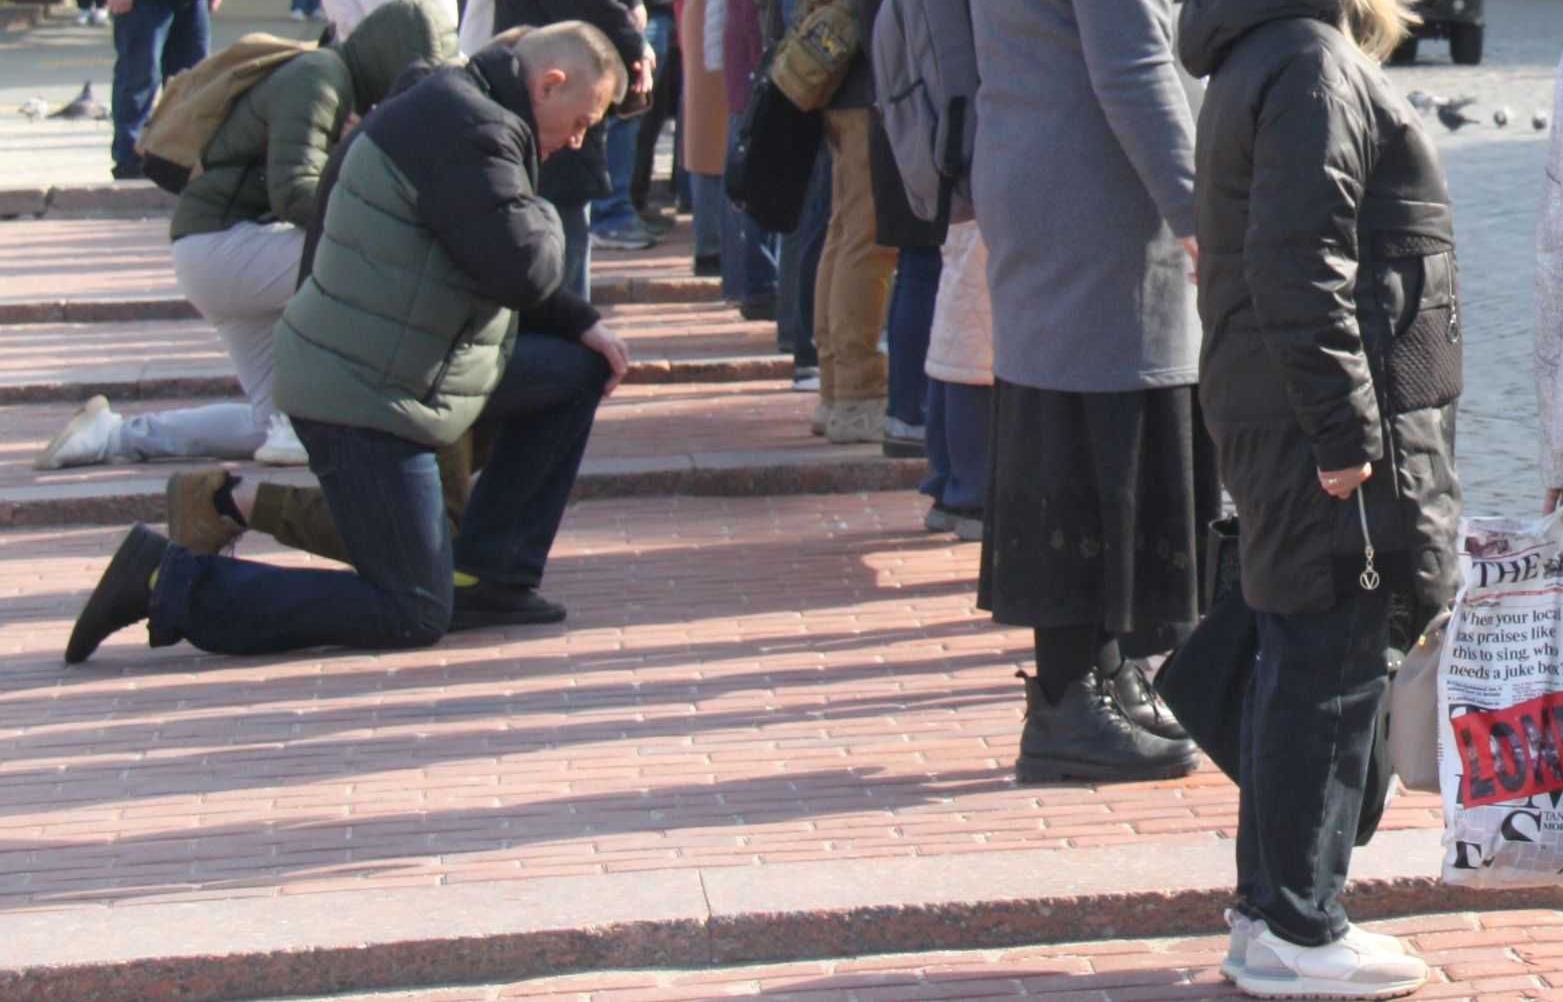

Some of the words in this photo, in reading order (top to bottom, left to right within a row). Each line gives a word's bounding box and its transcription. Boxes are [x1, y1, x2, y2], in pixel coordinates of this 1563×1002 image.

[1472, 552, 1541, 588] THE
[1495, 613, 1529, 627] your
[1477, 629, 1528, 646] praises
[1531, 627, 1557, 641] like
[1452, 645, 1477, 660] this
[1480, 648, 1493, 662] to
[1450, 663, 1490, 680] needs
[1493, 670, 1501, 680] a
[1502, 664, 1535, 681] juke
